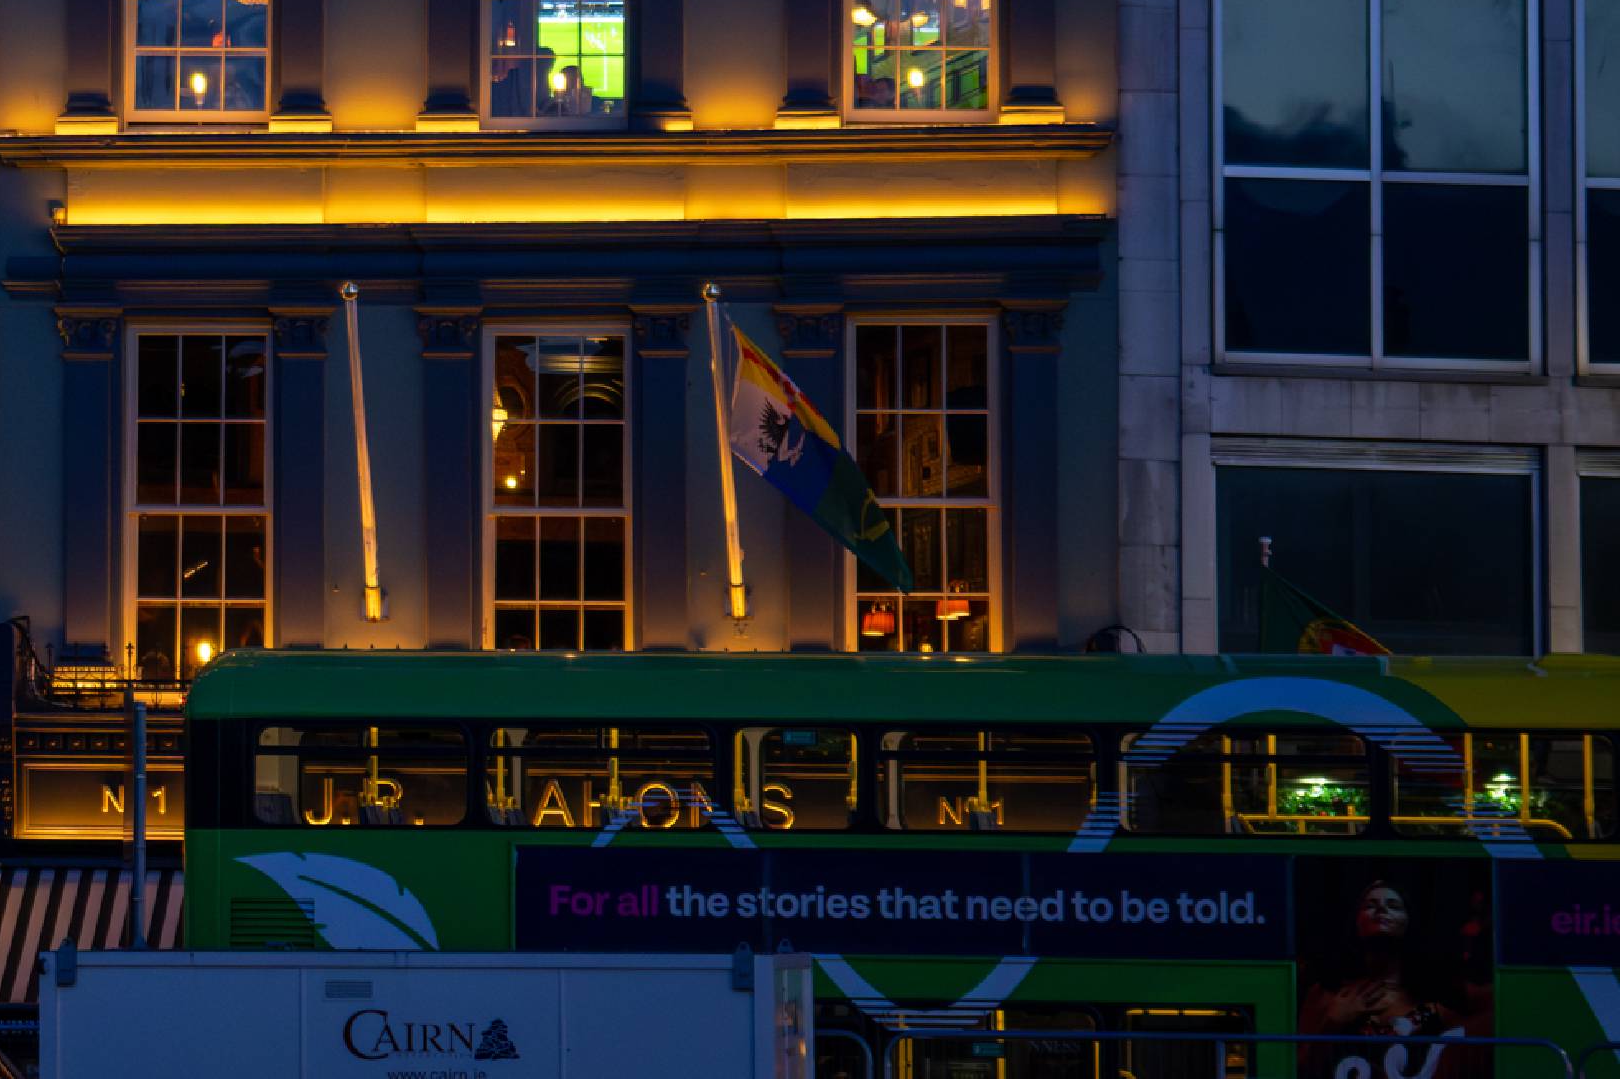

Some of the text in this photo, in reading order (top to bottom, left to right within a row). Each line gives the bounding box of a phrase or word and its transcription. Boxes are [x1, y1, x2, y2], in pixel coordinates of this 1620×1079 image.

[305, 777, 351, 826] J.
[548, 884, 1266, 925] For all the stories that need to be told.
[343, 1009, 476, 1060] CAIRN
